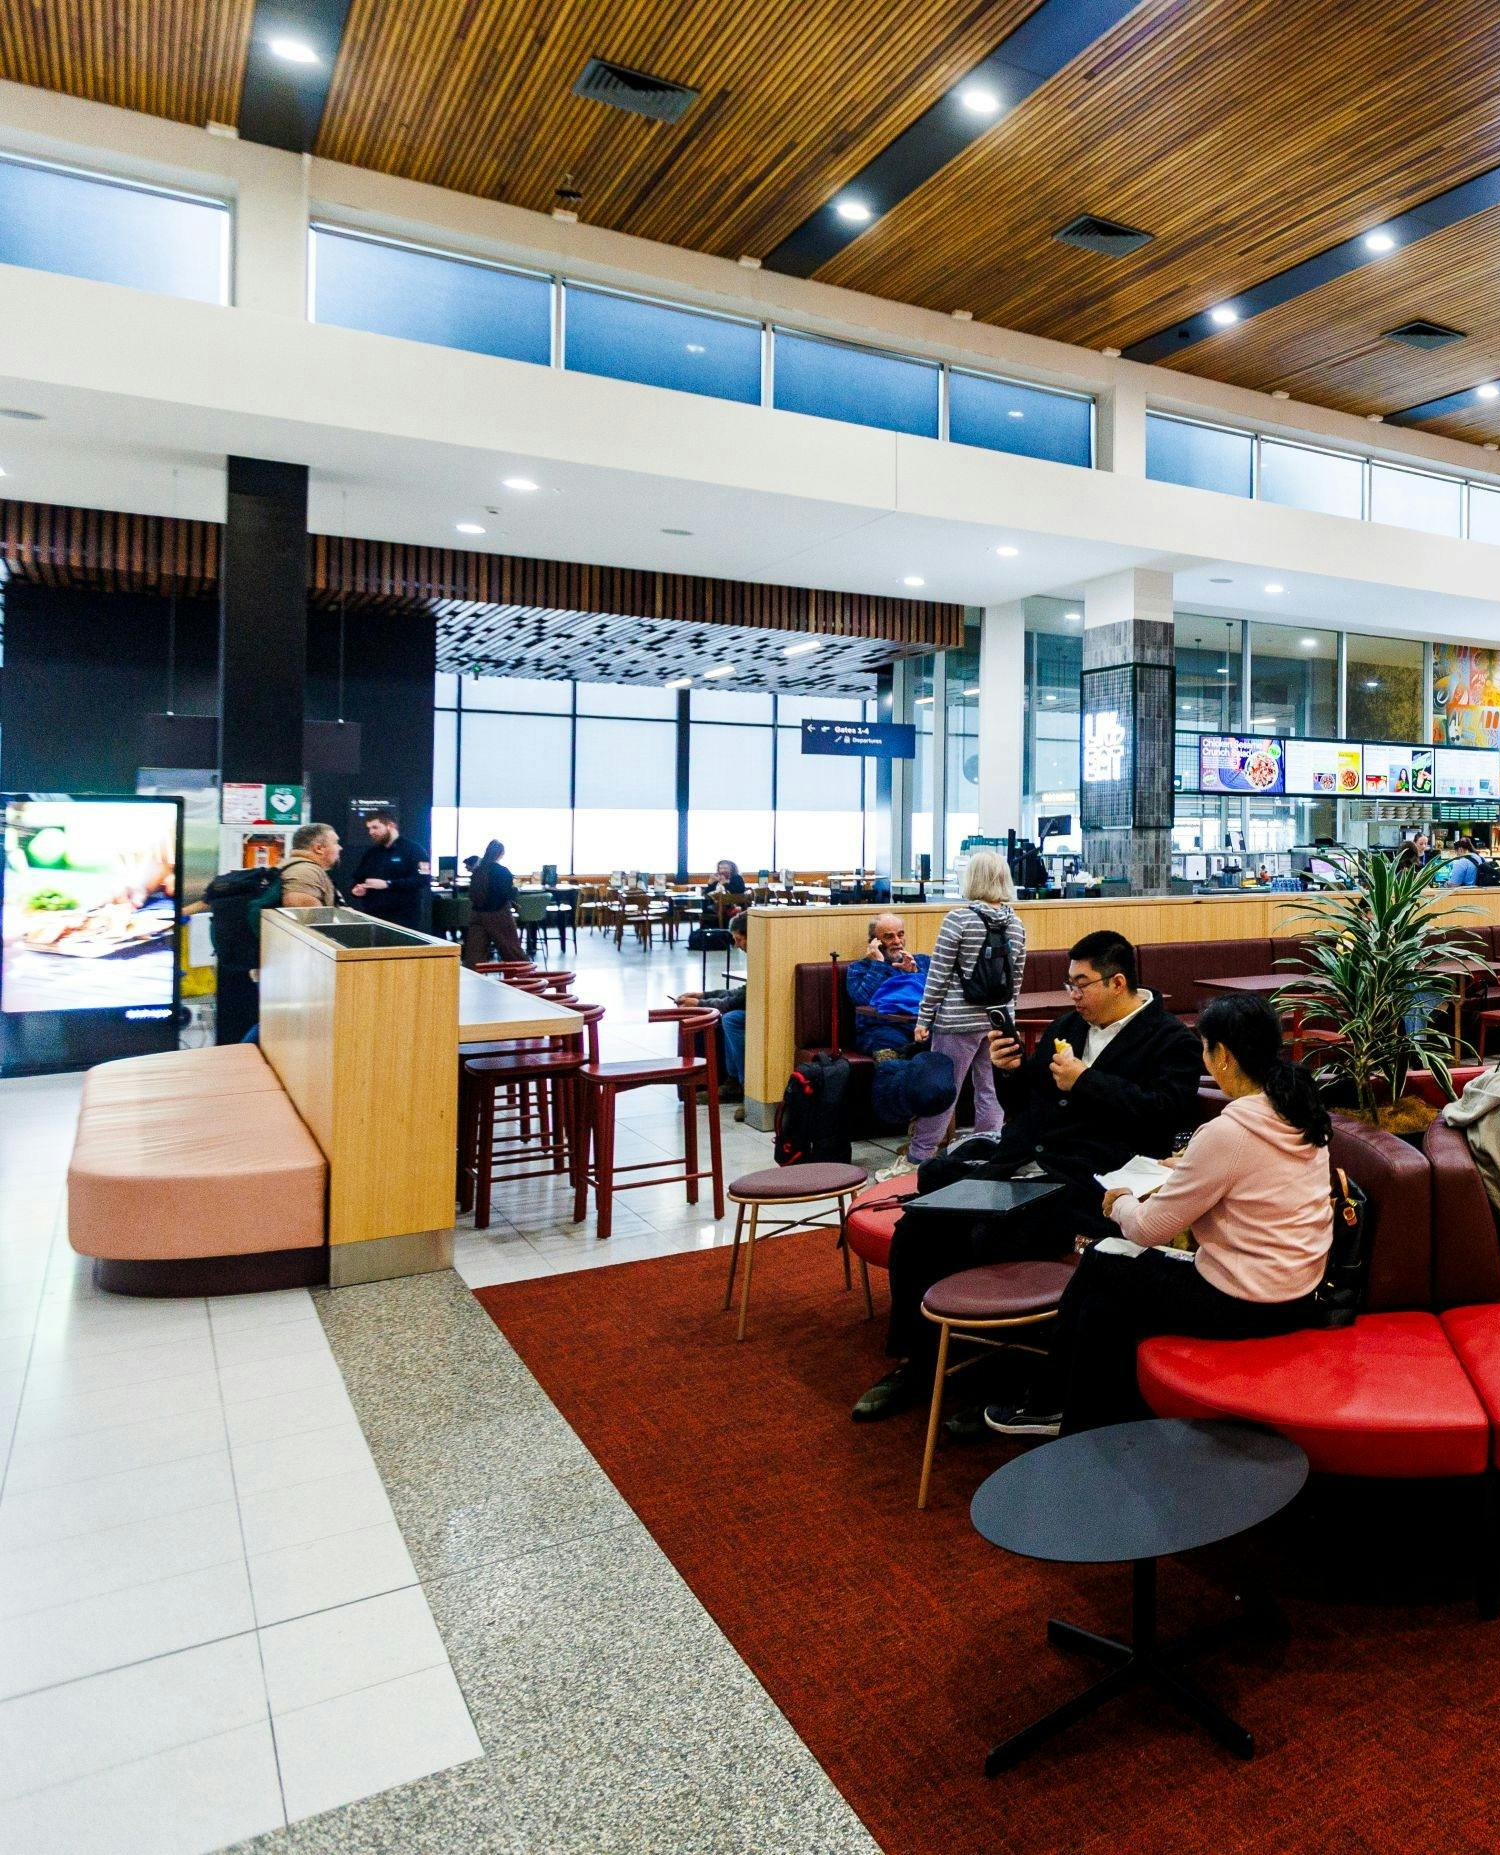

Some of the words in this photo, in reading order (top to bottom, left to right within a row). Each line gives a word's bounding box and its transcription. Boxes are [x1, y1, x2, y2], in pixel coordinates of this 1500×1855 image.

[834, 726, 857, 735] Gates
[852, 737, 883, 745] Departures
[1202, 738, 1230, 748] Chicken
[1202, 747, 1230, 756] Crunch
